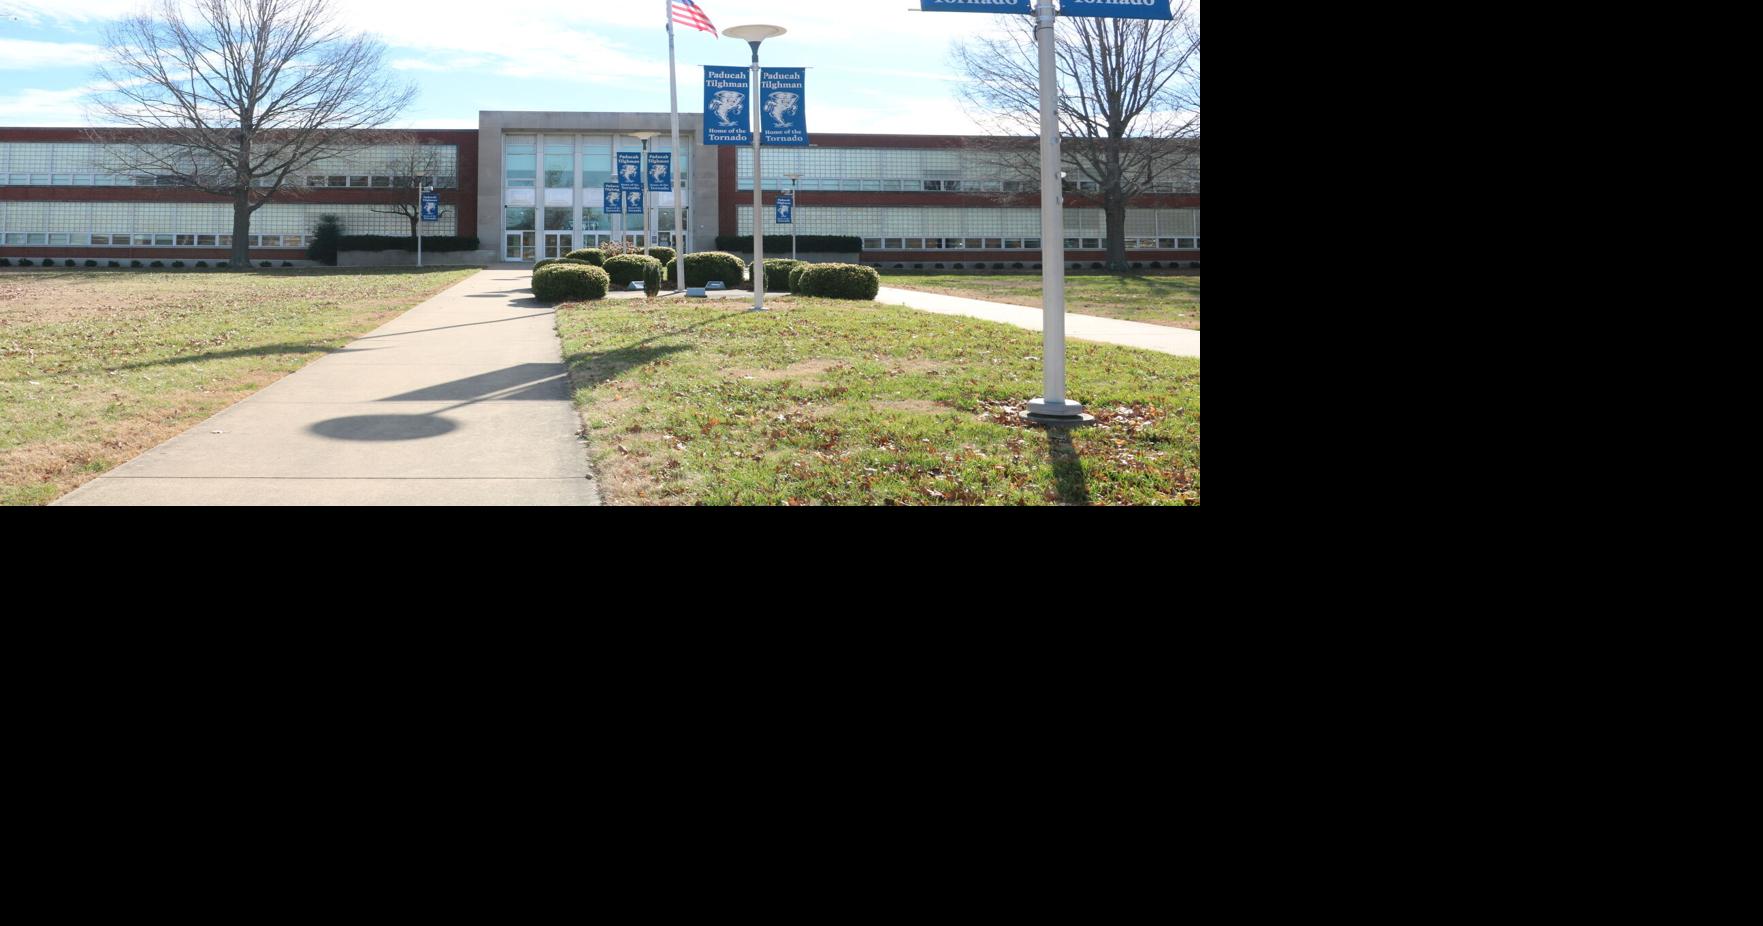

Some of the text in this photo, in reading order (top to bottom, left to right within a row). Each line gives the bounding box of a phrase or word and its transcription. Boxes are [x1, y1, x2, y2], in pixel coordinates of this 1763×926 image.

[708, 71, 746, 79] Paducah
[763, 72, 800, 80] Paducah
[705, 79, 748, 88] Tilghman
[761, 81, 802, 90] Tilghman
[708, 133, 747, 141] Tornado
